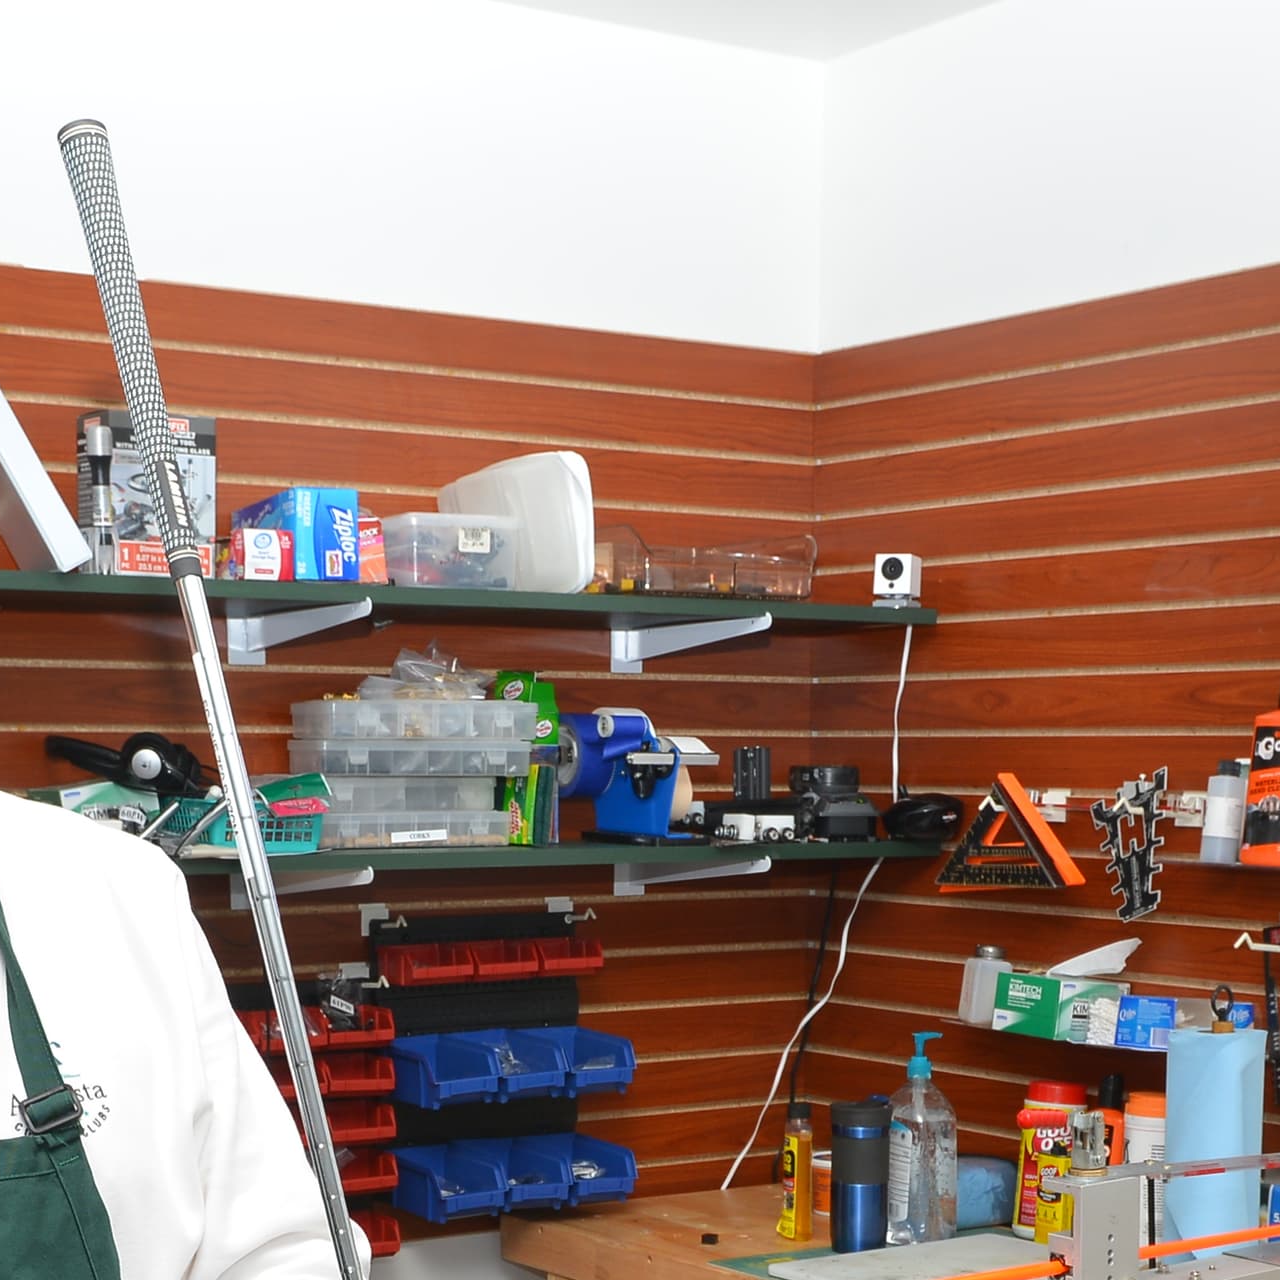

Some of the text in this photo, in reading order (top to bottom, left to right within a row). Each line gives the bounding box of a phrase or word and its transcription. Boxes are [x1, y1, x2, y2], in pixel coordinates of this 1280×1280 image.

[163, 461, 189, 528] LAMKIN
[331, 507, 357, 563] Ziploc
[10, 1083, 107, 1117] Asta
